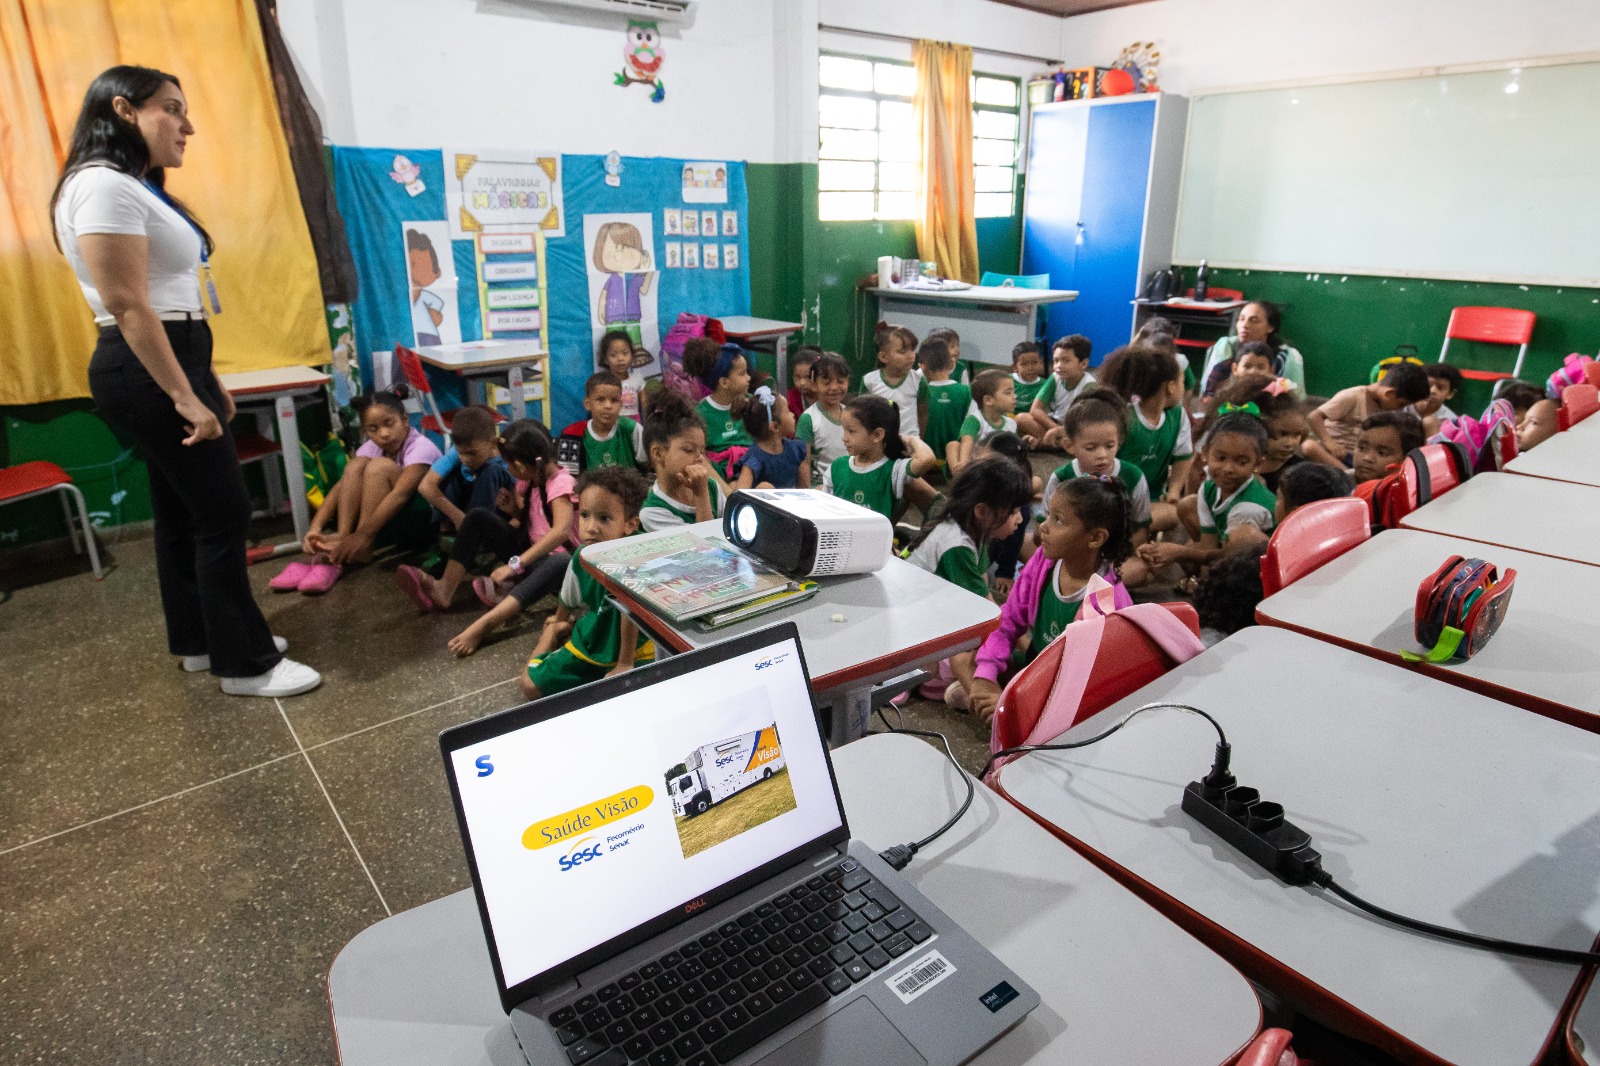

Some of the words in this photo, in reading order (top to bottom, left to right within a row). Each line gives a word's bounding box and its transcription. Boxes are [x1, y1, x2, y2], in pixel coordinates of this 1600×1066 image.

[757, 747, 779, 762] Visão
[541, 815, 592, 844] Saúde
[595, 796, 639, 821] Visão
[685, 898, 707, 913] DELL
